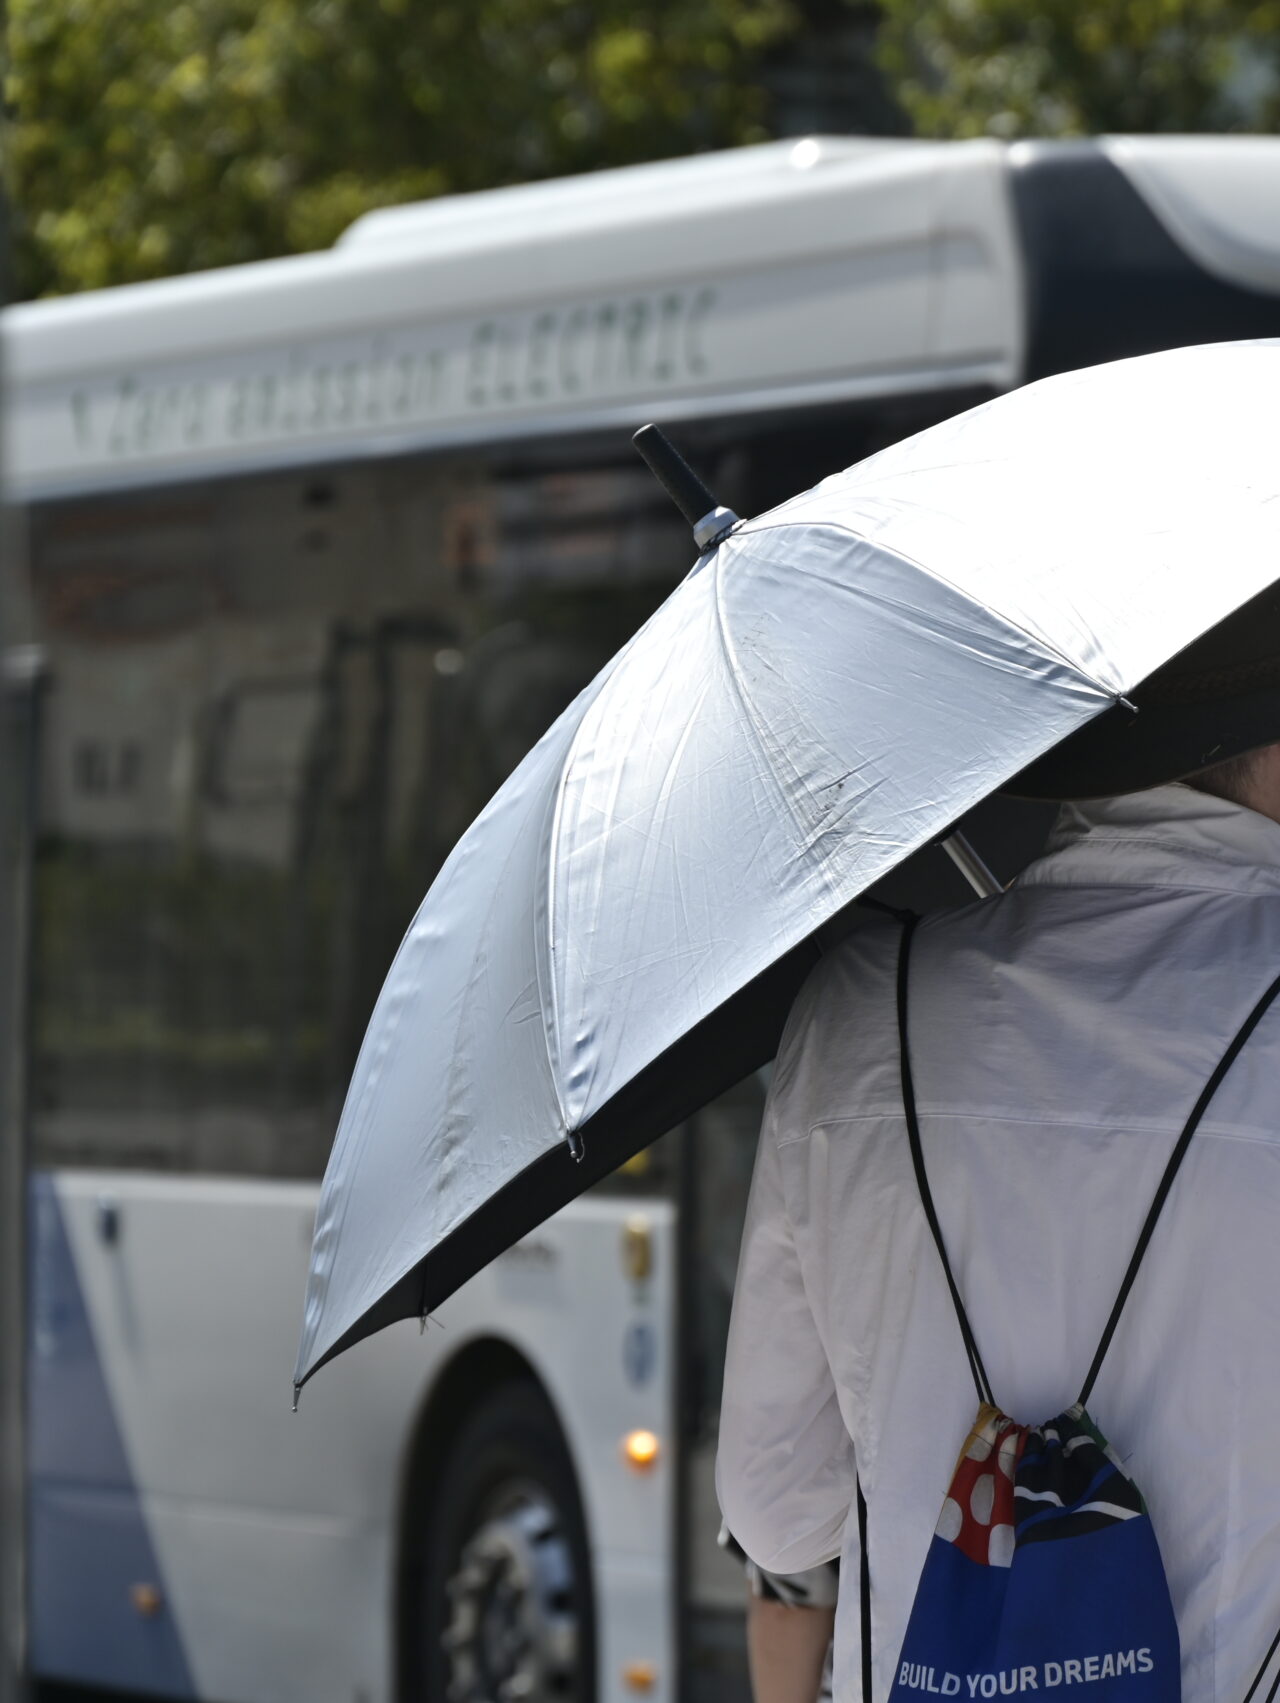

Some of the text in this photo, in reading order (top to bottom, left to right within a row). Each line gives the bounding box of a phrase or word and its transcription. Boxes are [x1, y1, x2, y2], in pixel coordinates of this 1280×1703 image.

[468, 287, 716, 406] ELECTRIC
[899, 1647, 1154, 1698] BUILD YOUR DREAMS
